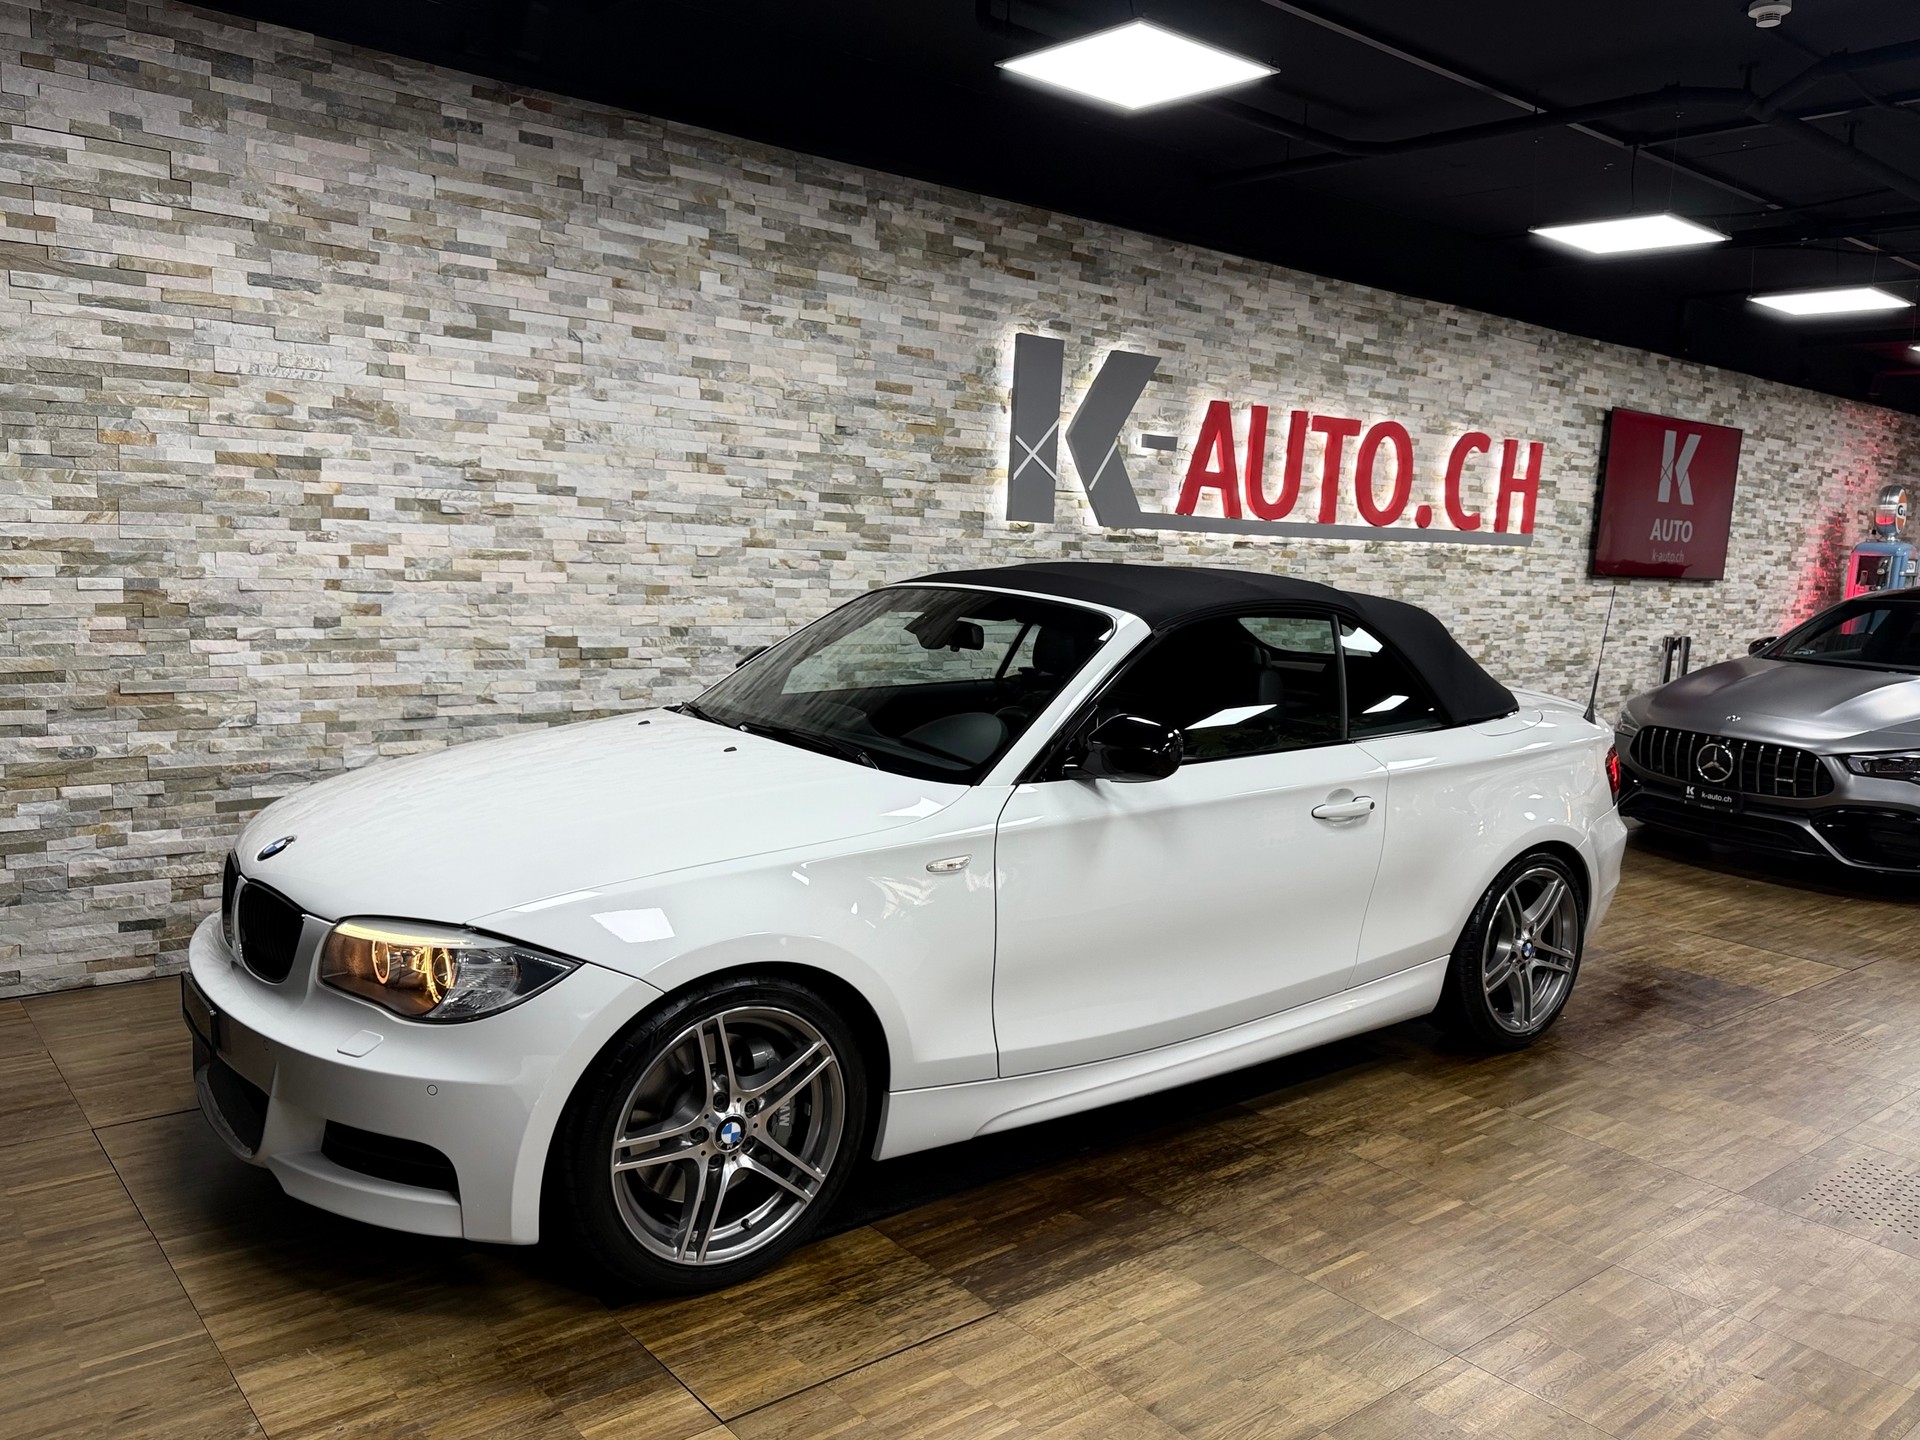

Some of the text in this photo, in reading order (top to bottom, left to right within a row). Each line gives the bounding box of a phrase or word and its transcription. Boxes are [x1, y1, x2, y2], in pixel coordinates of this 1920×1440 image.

[1006, 333, 1544, 534] K-AUTO.CH
[1657, 429, 1702, 506] K
[1649, 518, 1693, 543] AUTO
[1701, 791, 1732, 803] k-auto.ch
[779, 1099, 790, 1126] MW
